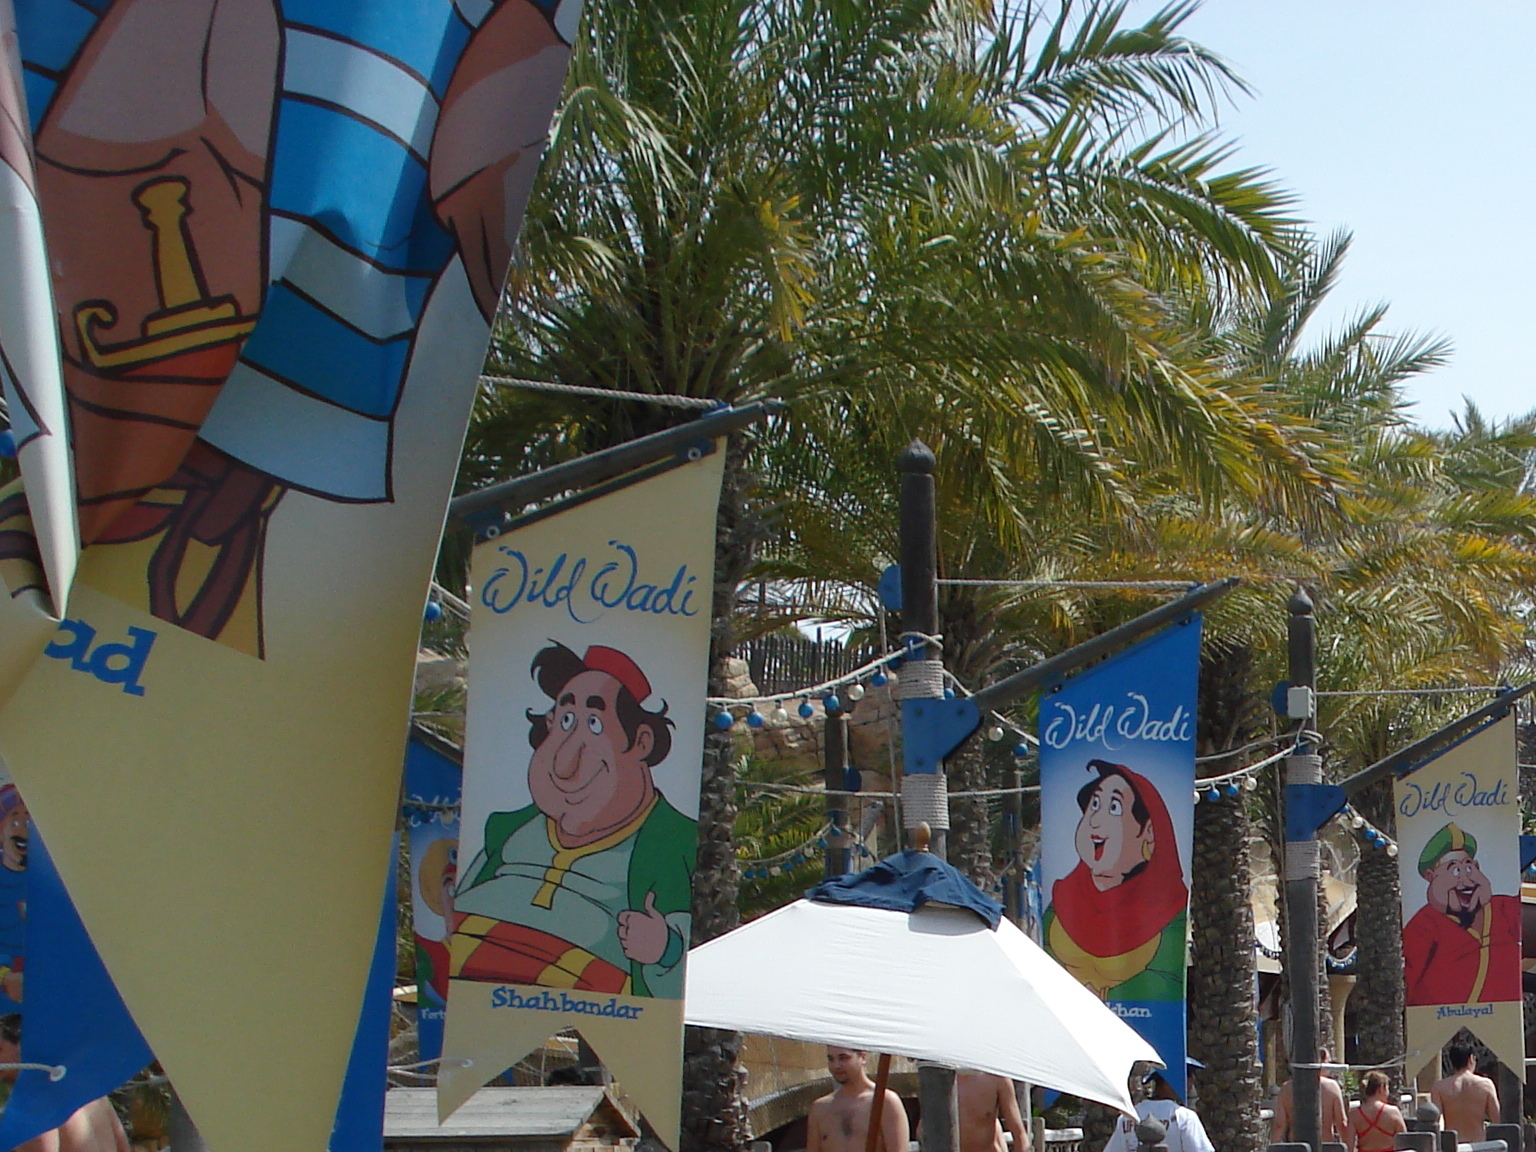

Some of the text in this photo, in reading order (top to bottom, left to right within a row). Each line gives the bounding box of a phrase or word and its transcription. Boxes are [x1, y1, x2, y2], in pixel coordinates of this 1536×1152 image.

[482, 540, 699, 624] Wild Wadi
[1045, 691, 1191, 751] Wild Wadi
[1399, 771, 1511, 817] Wild Wadi
[492, 985, 644, 1020] Shahbandar
[1437, 1003, 1494, 1020] Abulayal
